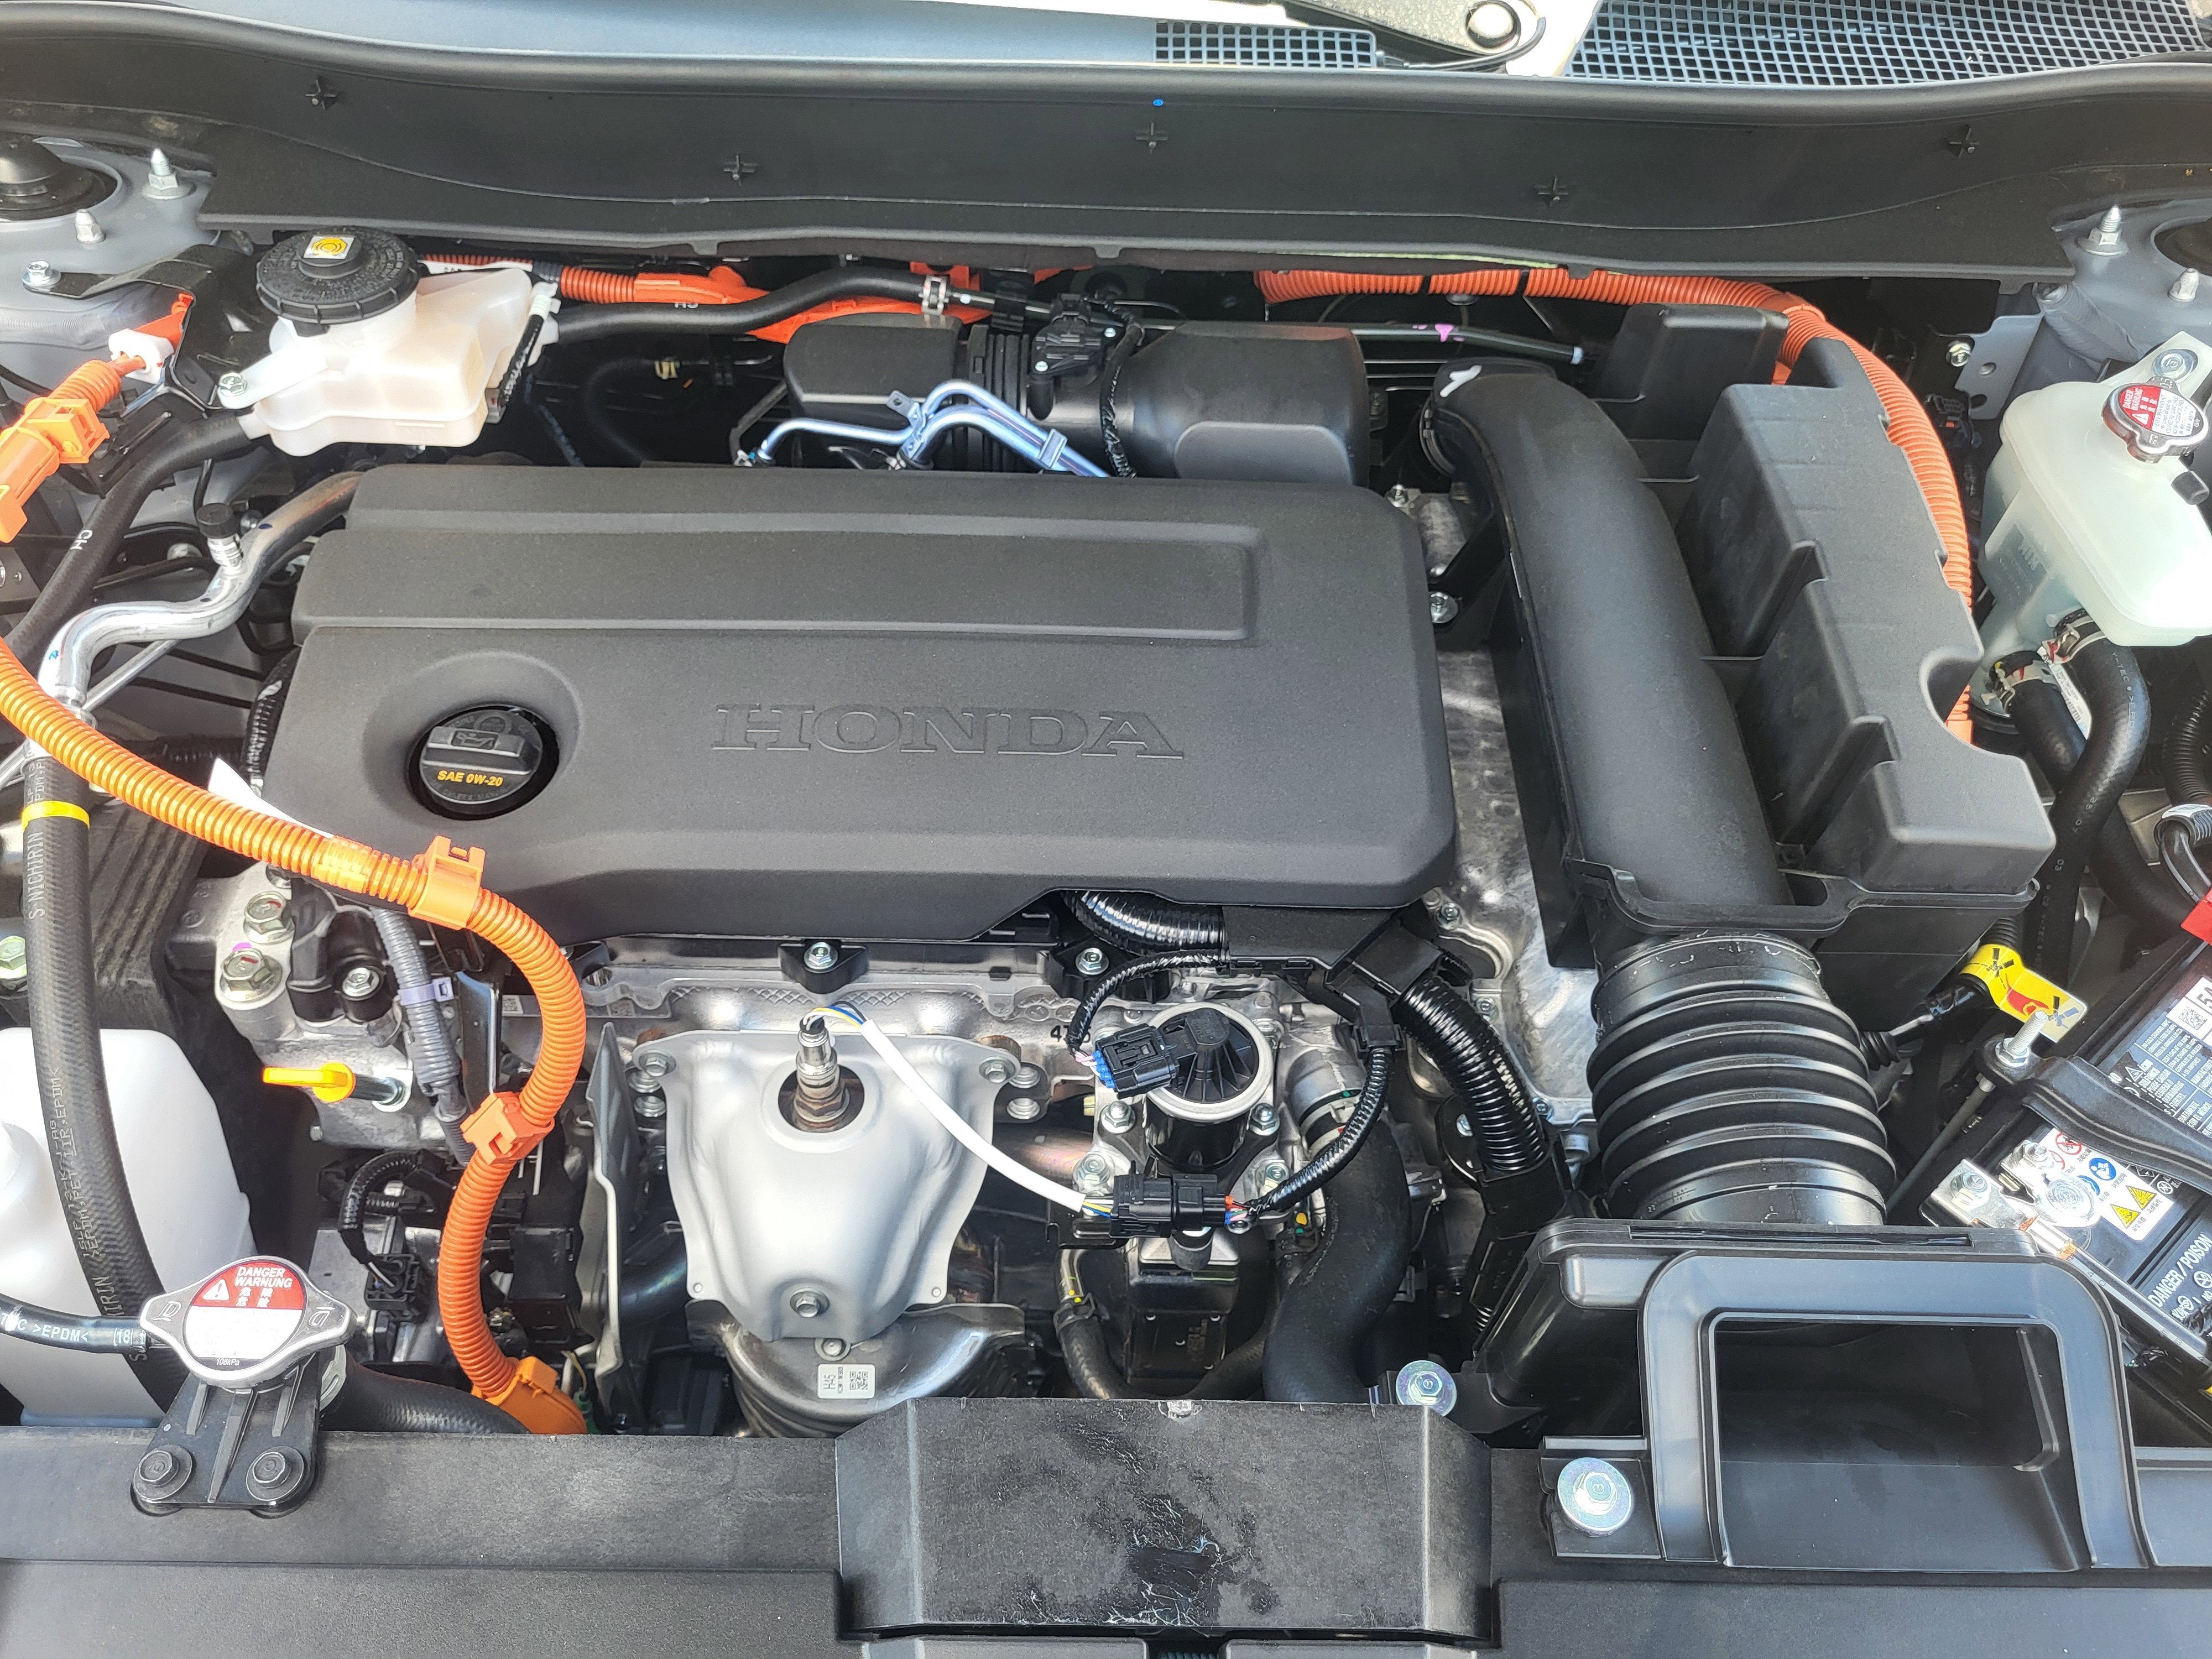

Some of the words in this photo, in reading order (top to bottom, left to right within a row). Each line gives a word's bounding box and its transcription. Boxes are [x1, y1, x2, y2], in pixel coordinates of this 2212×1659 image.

[2122, 389, 2133, 409] DANGER
[711, 703, 1183, 759] HONDA
[437, 770, 465, 782] SAE
[465, 773, 504, 787] 0W-20
[2162, 1055, 2171, 1063] TEST
[2167, 1048, 2177, 1057] LOAD
[2180, 1034, 2190, 1044] AMPS
[2147, 1080, 2161, 1094] PUEDE
[2156, 1068, 2172, 1083] CAUSAR
[2154, 1081, 2172, 1099] CEGUERA
[2161, 1080, 2185, 1104] QUEMADURAS
[2168, 1091, 2187, 1109] FUERTES.
[2177, 1100, 2200, 1124] DIATAMENTE
[2186, 1117, 2198, 1128] CON
[237, 1266, 285, 1277] DANGER
[234, 1276, 294, 1288] WARNUNG
[33, 1324, 89, 1343] >EPDM<
[216, 1358, 241, 1366] 108kPa
